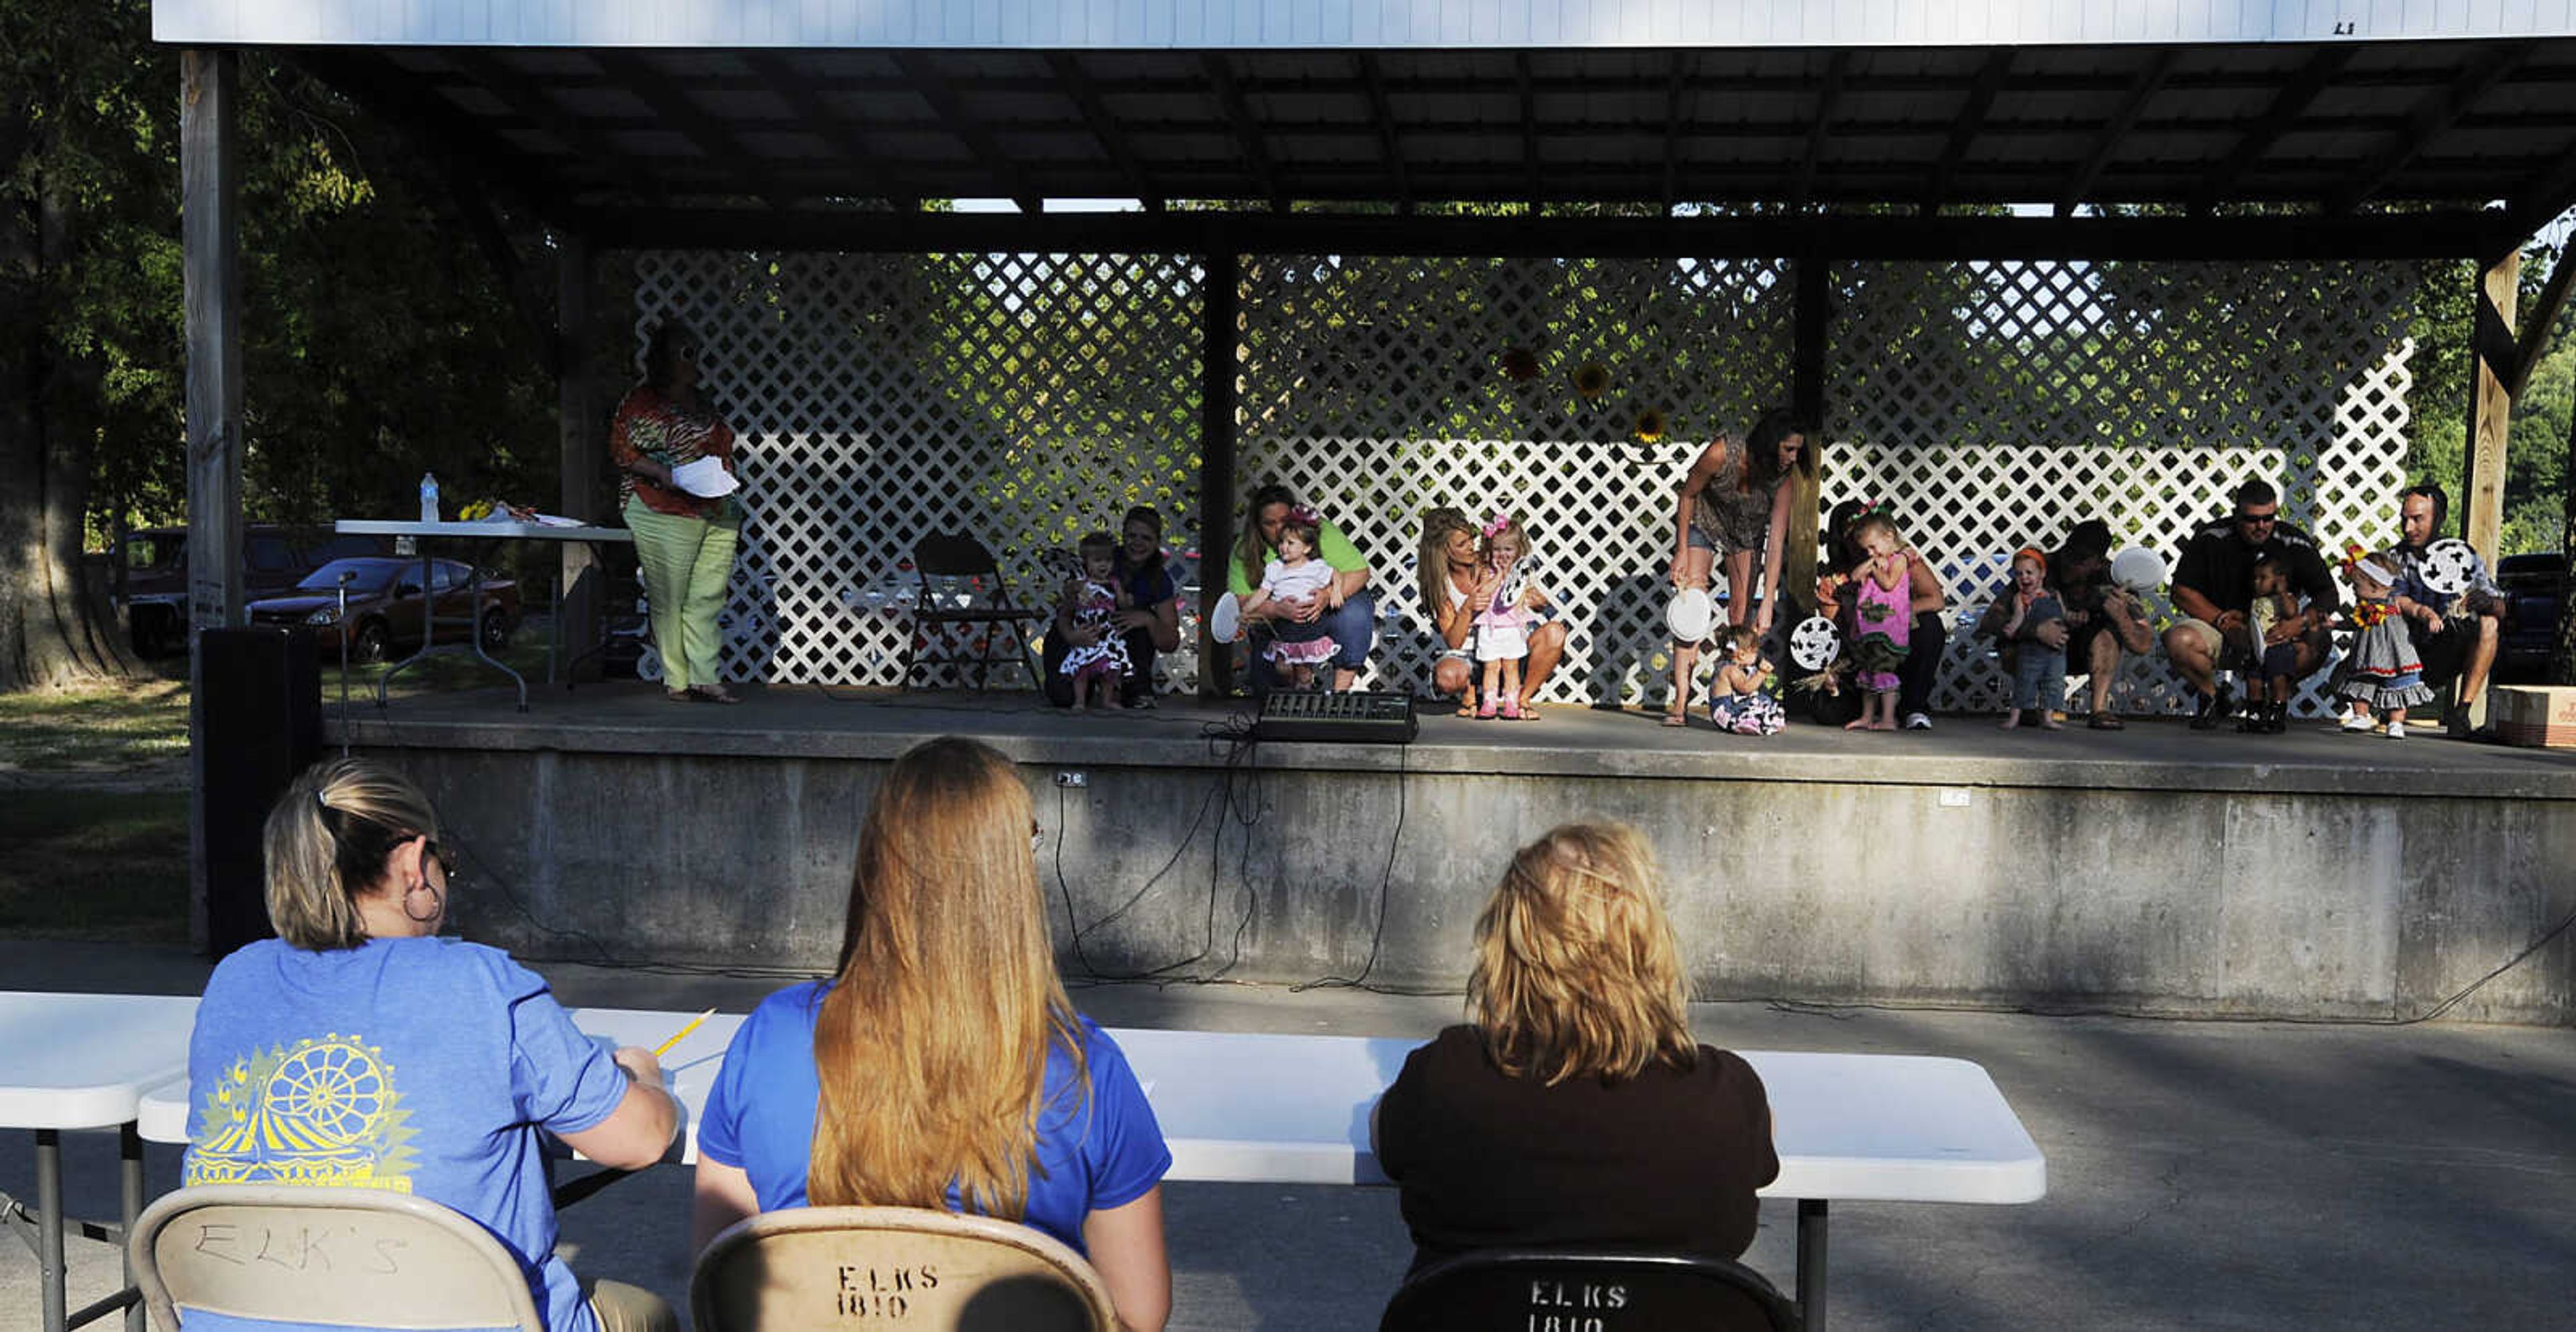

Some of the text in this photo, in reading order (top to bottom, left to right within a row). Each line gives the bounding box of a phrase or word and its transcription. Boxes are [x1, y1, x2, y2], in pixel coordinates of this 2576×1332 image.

[195, 1225, 408, 1274] ELK'S
[839, 1266, 938, 1292] ELKS
[838, 1294, 907, 1317] 1810
[1532, 1281, 1627, 1308] ELKS
